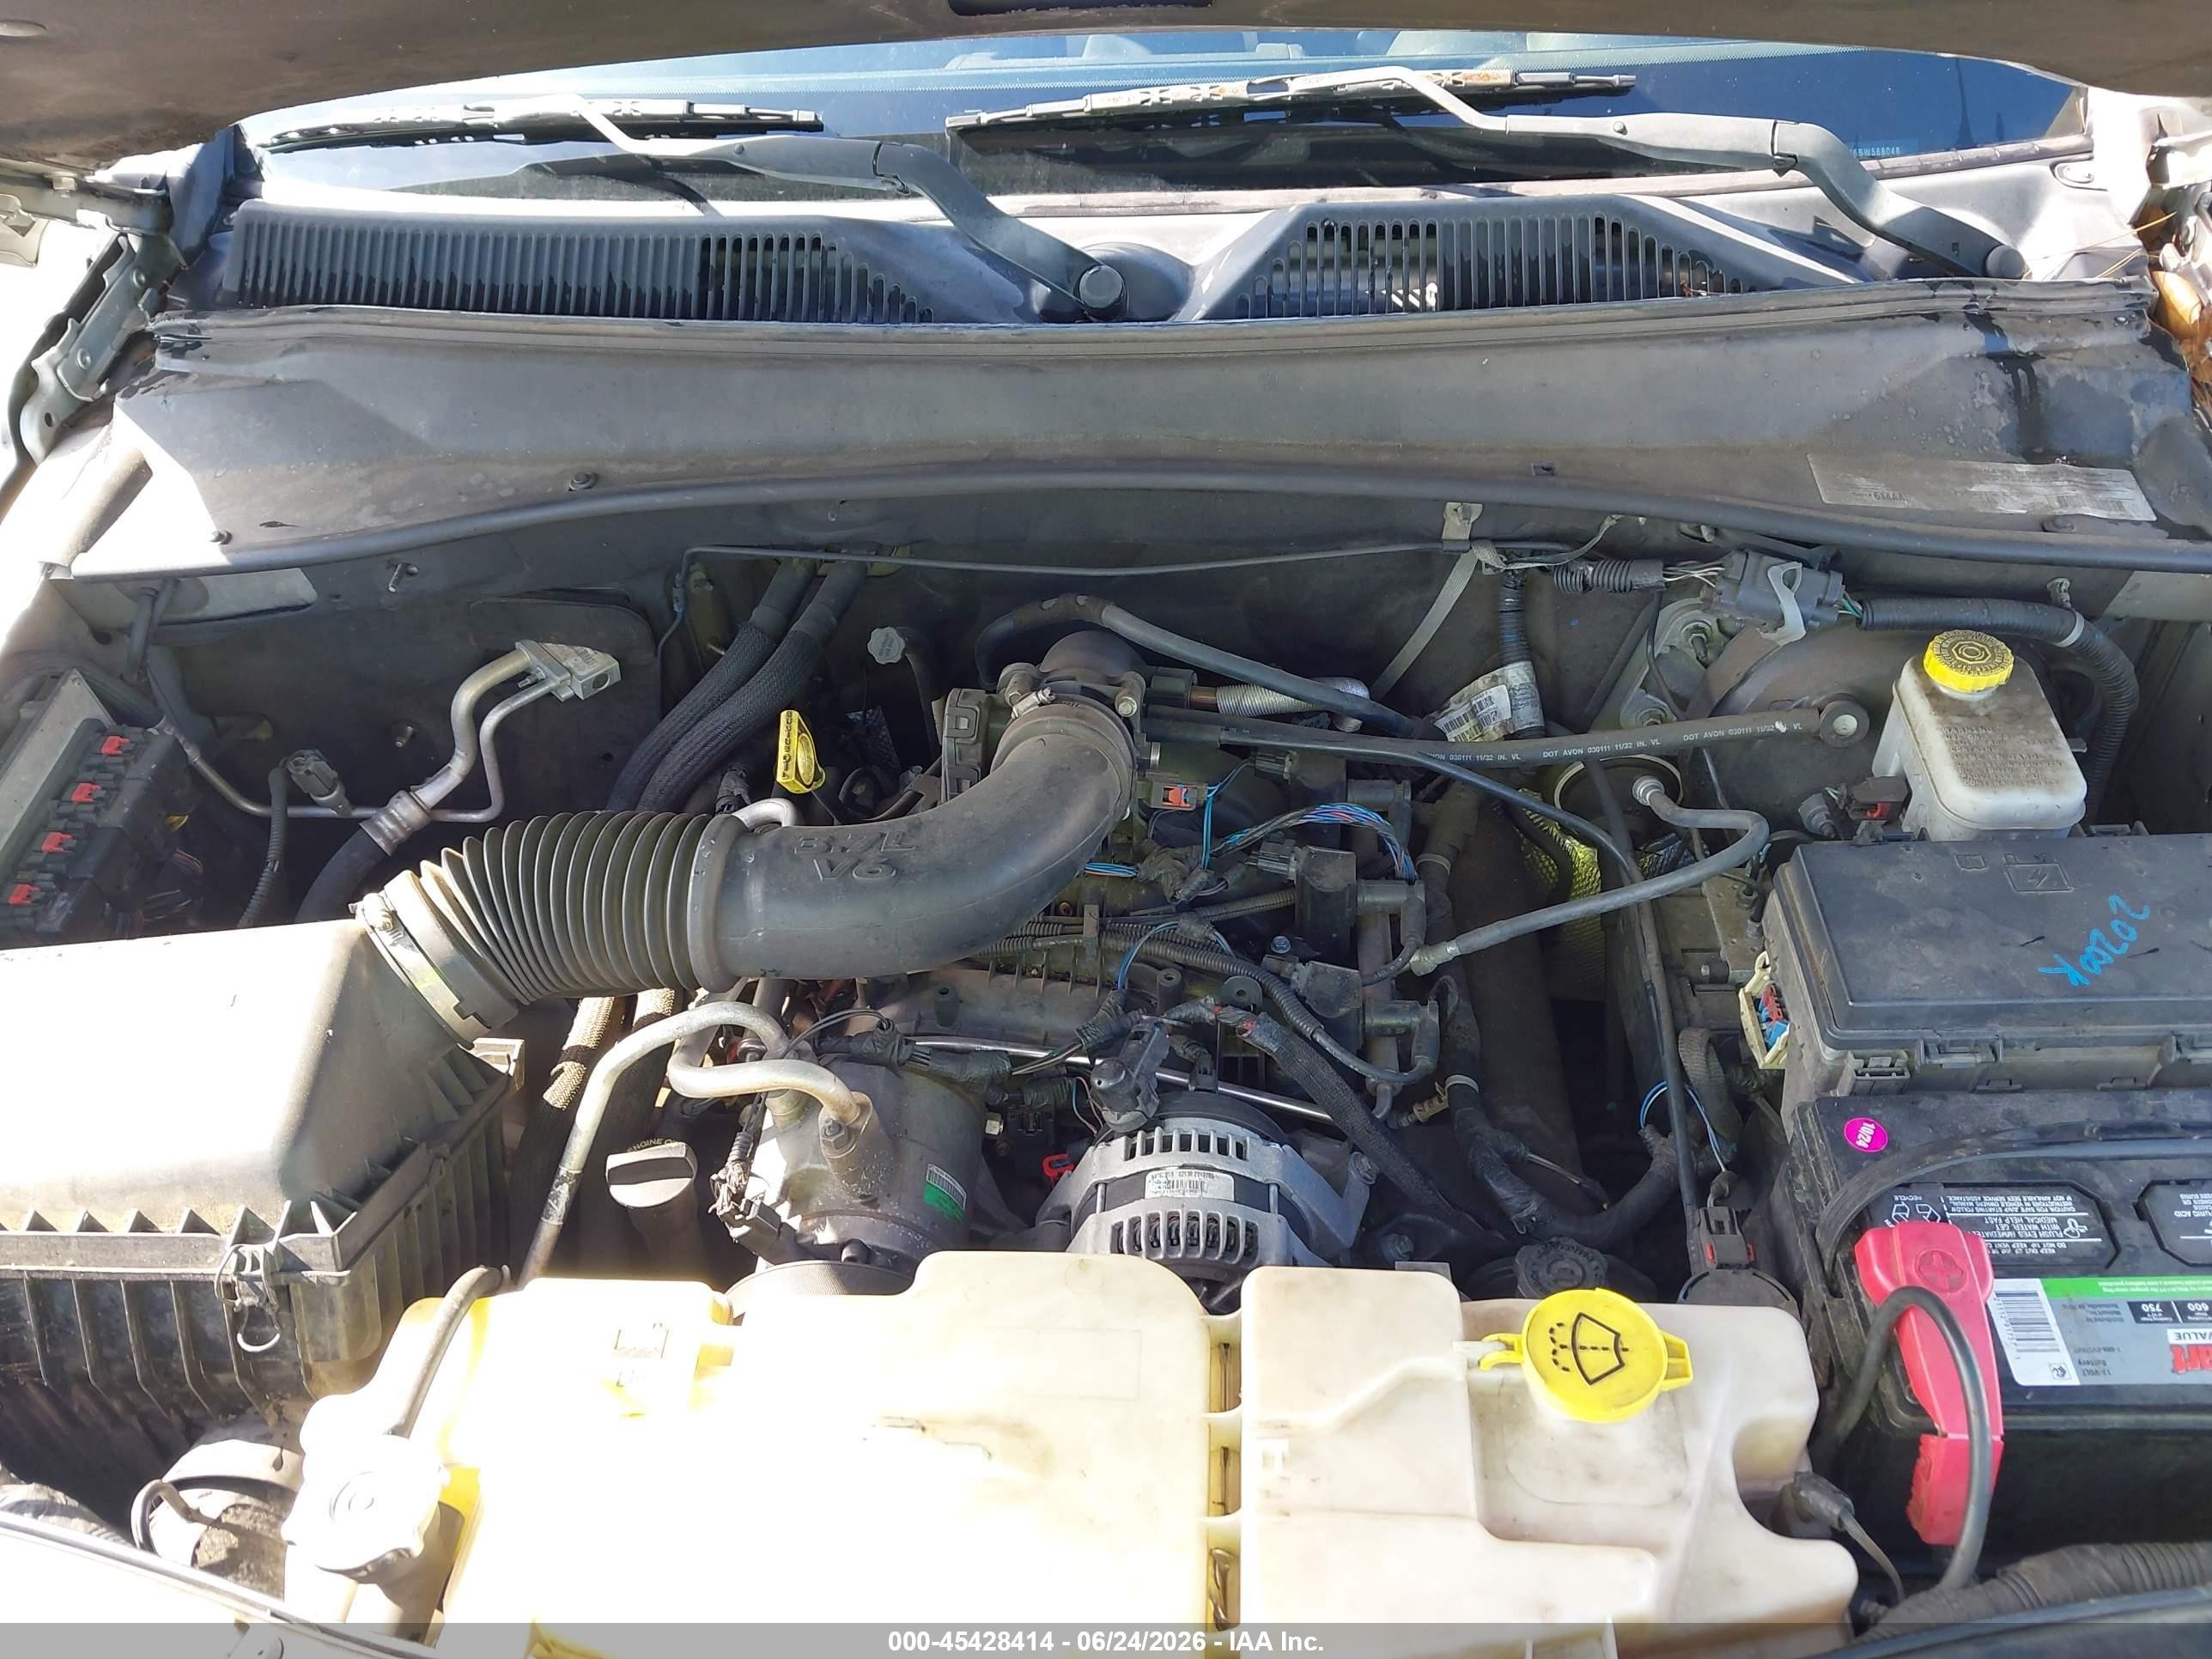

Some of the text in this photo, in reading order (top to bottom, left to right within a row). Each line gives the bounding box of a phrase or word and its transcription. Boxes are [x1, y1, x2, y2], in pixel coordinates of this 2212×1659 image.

[1703, 731, 1724, 739] AVON
[1587, 745, 1611, 754] 030111
[812, 858, 897, 882] V6
[1856, 1121, 1875, 1148] 10/24
[2141, 1303, 2163, 1312] 750
[2187, 1302, 2209, 1311] 600
